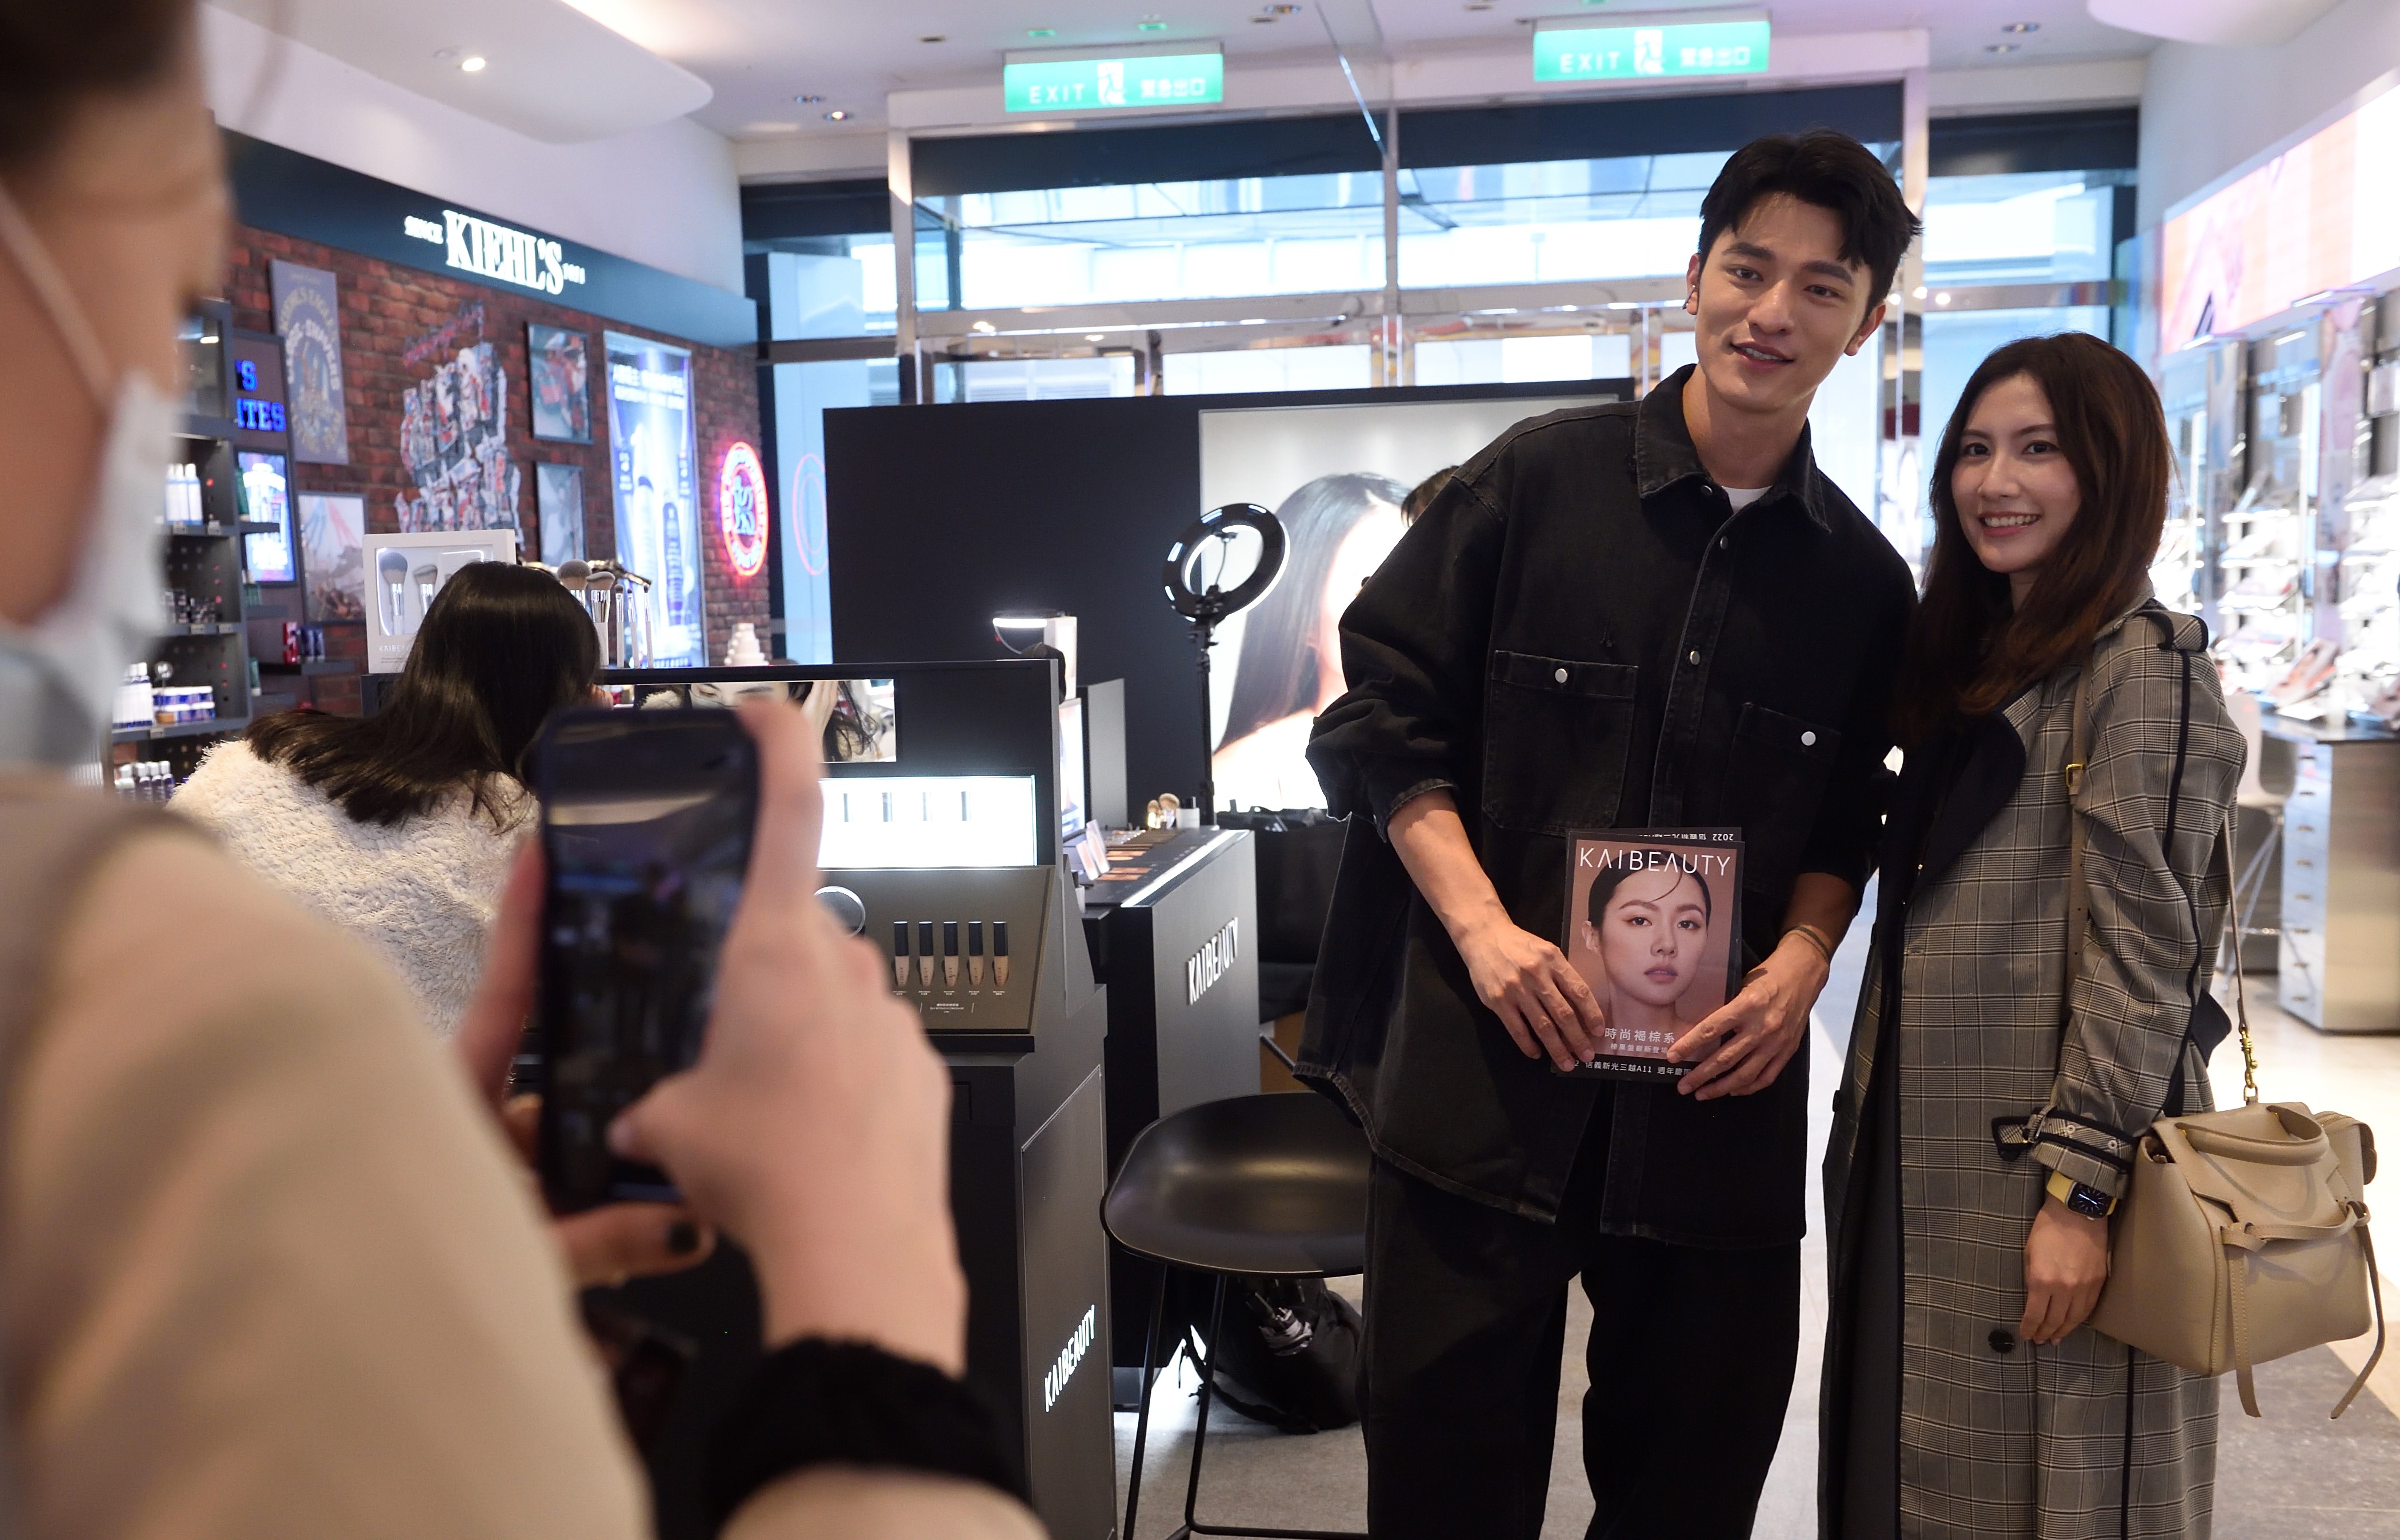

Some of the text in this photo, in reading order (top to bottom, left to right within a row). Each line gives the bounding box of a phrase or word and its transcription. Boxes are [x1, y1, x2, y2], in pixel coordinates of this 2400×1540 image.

[1559, 51, 1620, 73] EXIT
[1029, 83, 1085, 104] EXIT
[442, 210, 564, 295] KIEHL'S
[1579, 847, 1730, 876] KAIBEAUTY
[1188, 917, 1238, 1006] KAIBEAUTY
[1605, 1027, 1675, 1043] 時尚褐棕系
[1585, 1061, 1651, 1073] 信義新光三越A11
[1045, 1304, 1095, 1413] KAIBEAUTY
